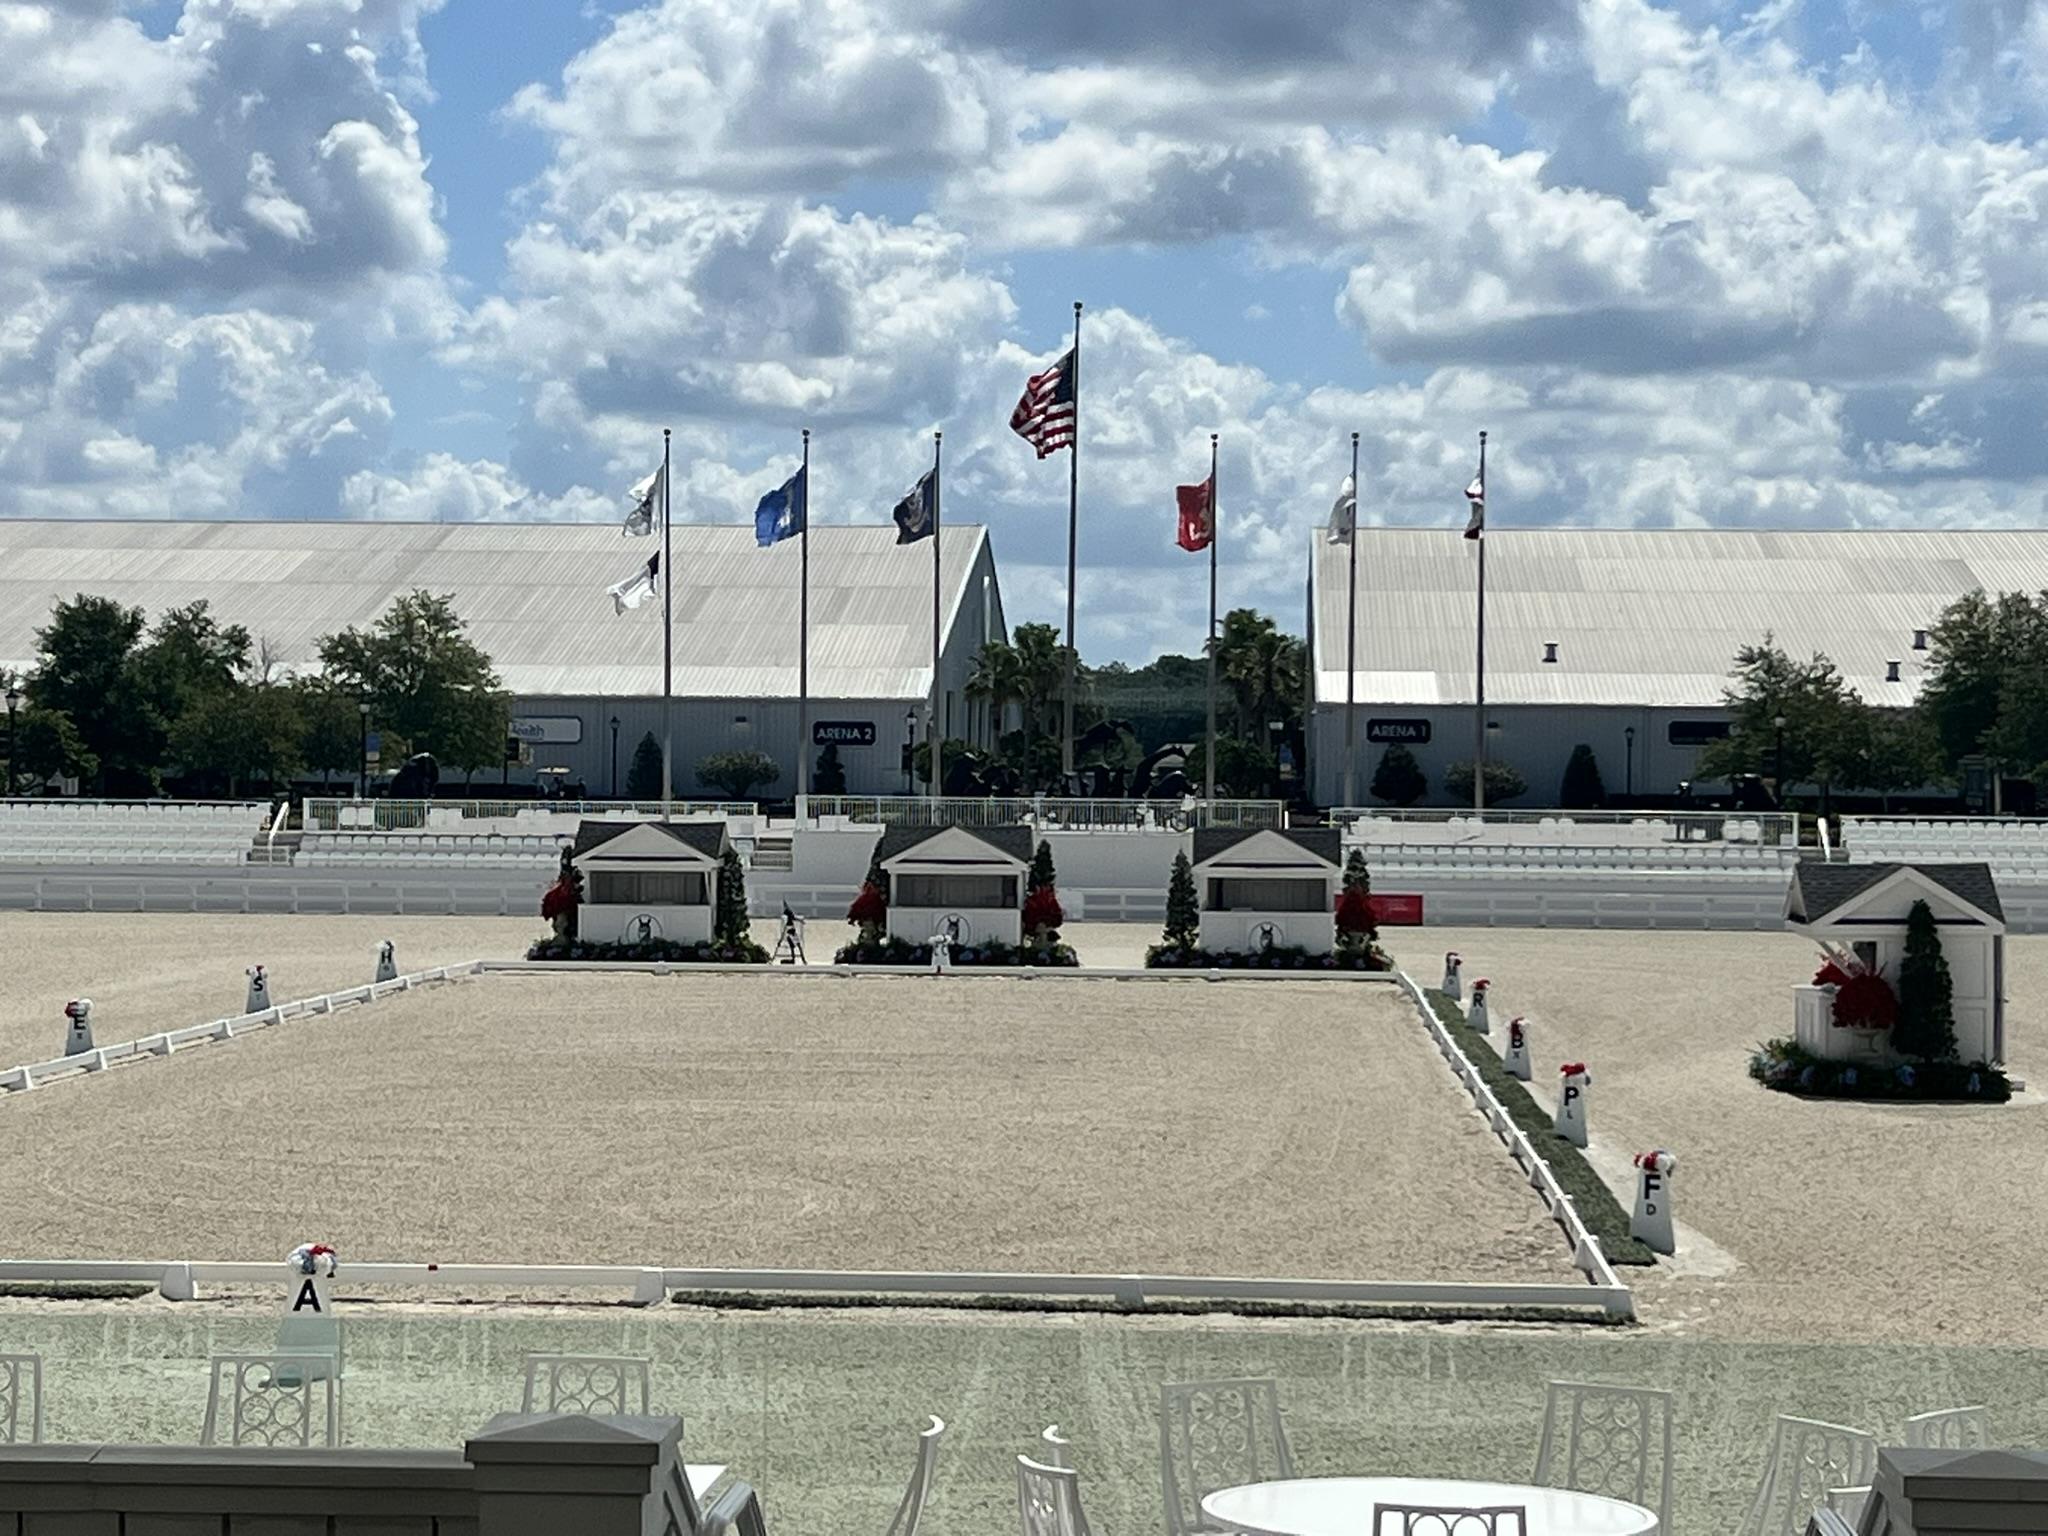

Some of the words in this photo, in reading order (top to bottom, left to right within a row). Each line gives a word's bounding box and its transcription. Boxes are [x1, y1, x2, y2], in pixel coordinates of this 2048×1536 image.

[816, 727, 861, 740] ARENA
[864, 727, 873, 740] 2
[1371, 725, 1416, 737] ARENA
[1421, 725, 1427, 737] 1
[381, 950, 392, 964] H
[253, 975, 263, 992] S
[1473, 992, 1484, 1008] R
[73, 1014, 87, 1030] E
[1511, 1031, 1524, 1048] B
[1564, 1086, 1580, 1107] P
[1644, 1174, 1661, 1200] F
[1646, 1203, 1657, 1216] D
[292, 1278, 322, 1313] A
